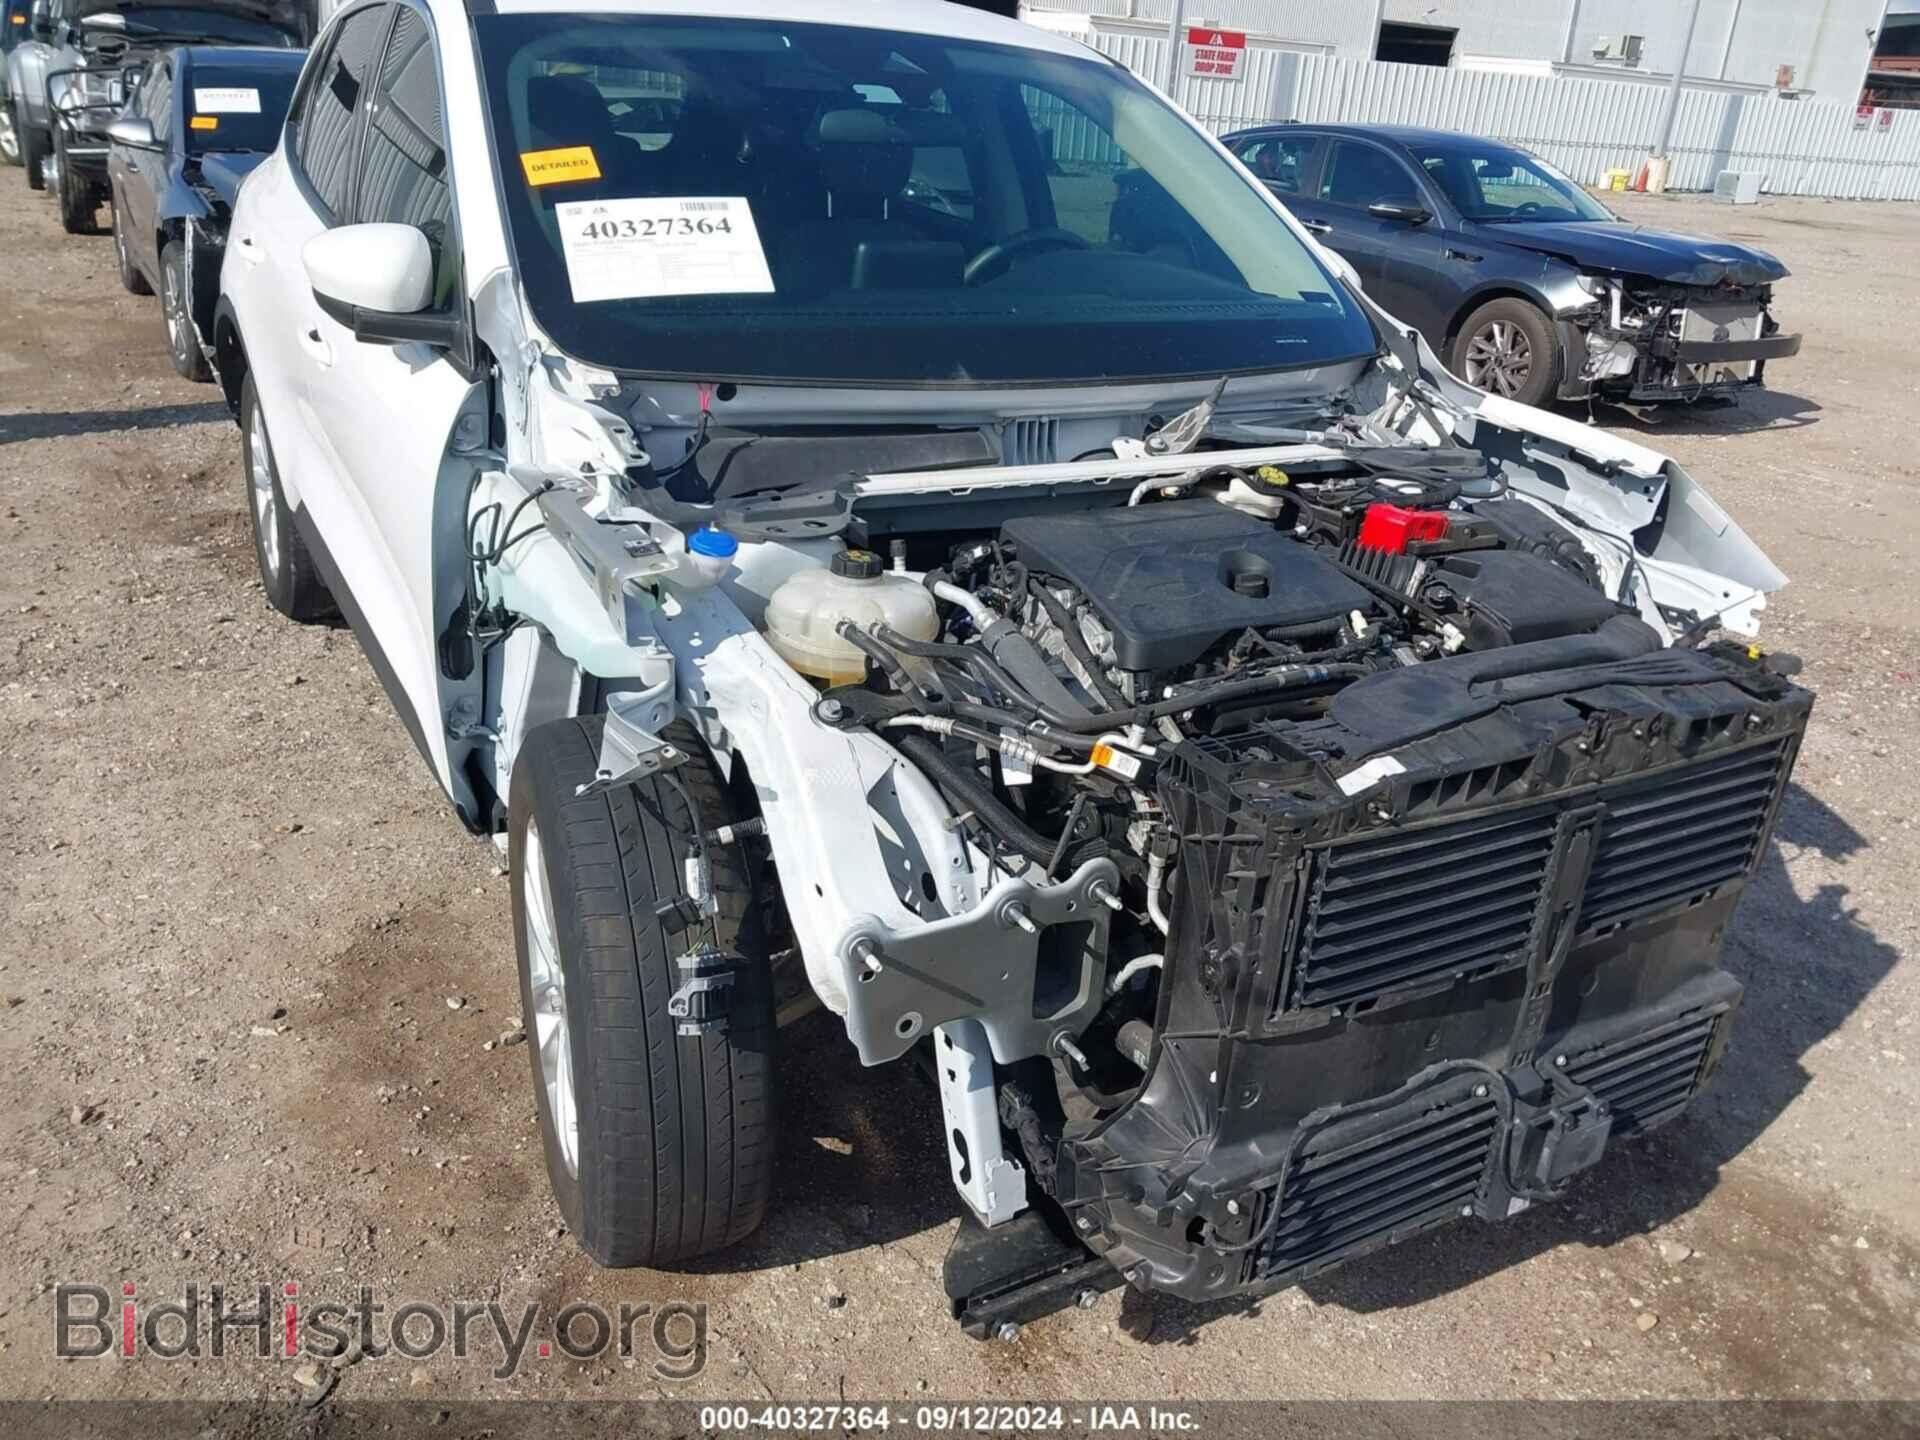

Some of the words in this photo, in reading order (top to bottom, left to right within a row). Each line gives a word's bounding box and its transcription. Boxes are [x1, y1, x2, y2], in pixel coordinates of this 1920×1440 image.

[1195, 48, 1216, 60] STATE
[1216, 50, 1237, 62] FARM
[1194, 61, 1215, 72] DROP
[1215, 63, 1234, 74] ZONE
[531, 158, 590, 173] DETAILED
[581, 216, 733, 240] 40327364
